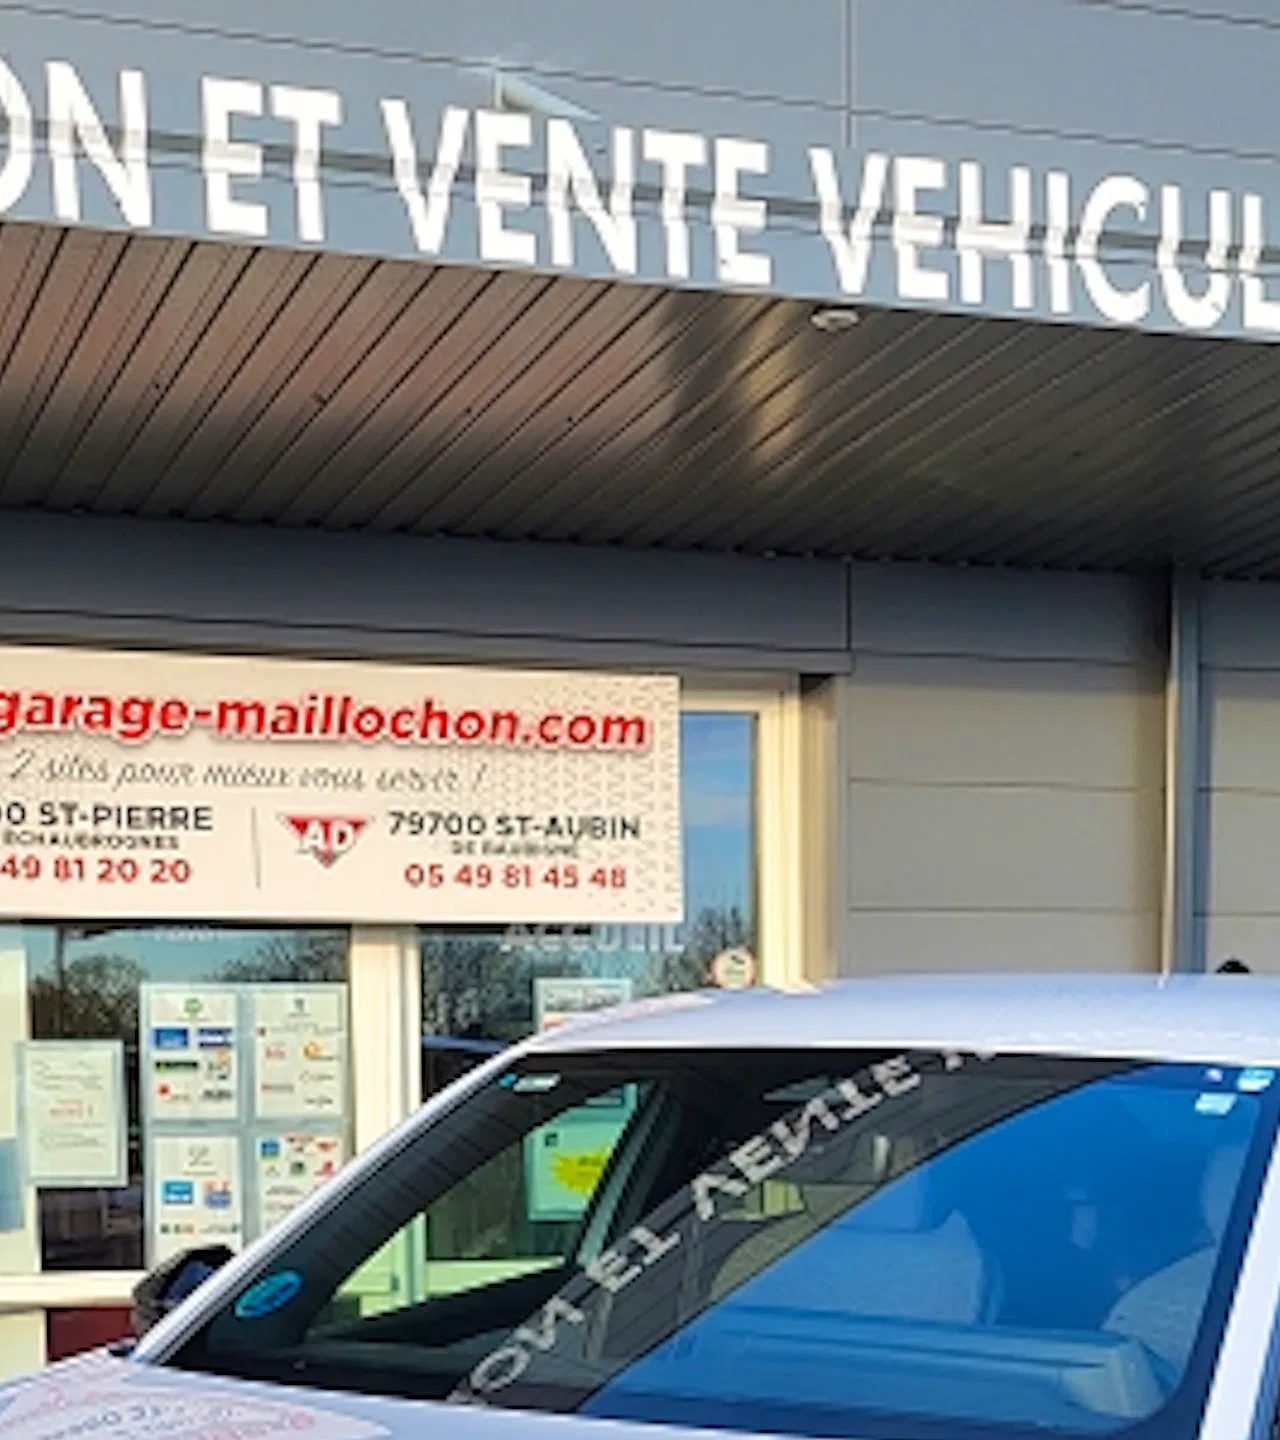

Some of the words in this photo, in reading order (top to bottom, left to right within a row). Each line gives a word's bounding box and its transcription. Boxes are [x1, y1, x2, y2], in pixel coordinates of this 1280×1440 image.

[202, 76, 340, 241] ET
[381, 98, 772, 284] VENTE
[38, 804, 213, 831] ST-PIERRE
[388, 811, 486, 835] 79700
[495, 815, 640, 840] ST-AUBIN
[0, 854, 40, 880] 49
[97, 858, 138, 882] 20
[151, 858, 190, 882] 20
[404, 864, 443, 887] 05
[454, 864, 491, 888] 49
[503, 864, 532, 887] 81
[543, 864, 578, 888] 45
[589, 867, 626, 888] 48
